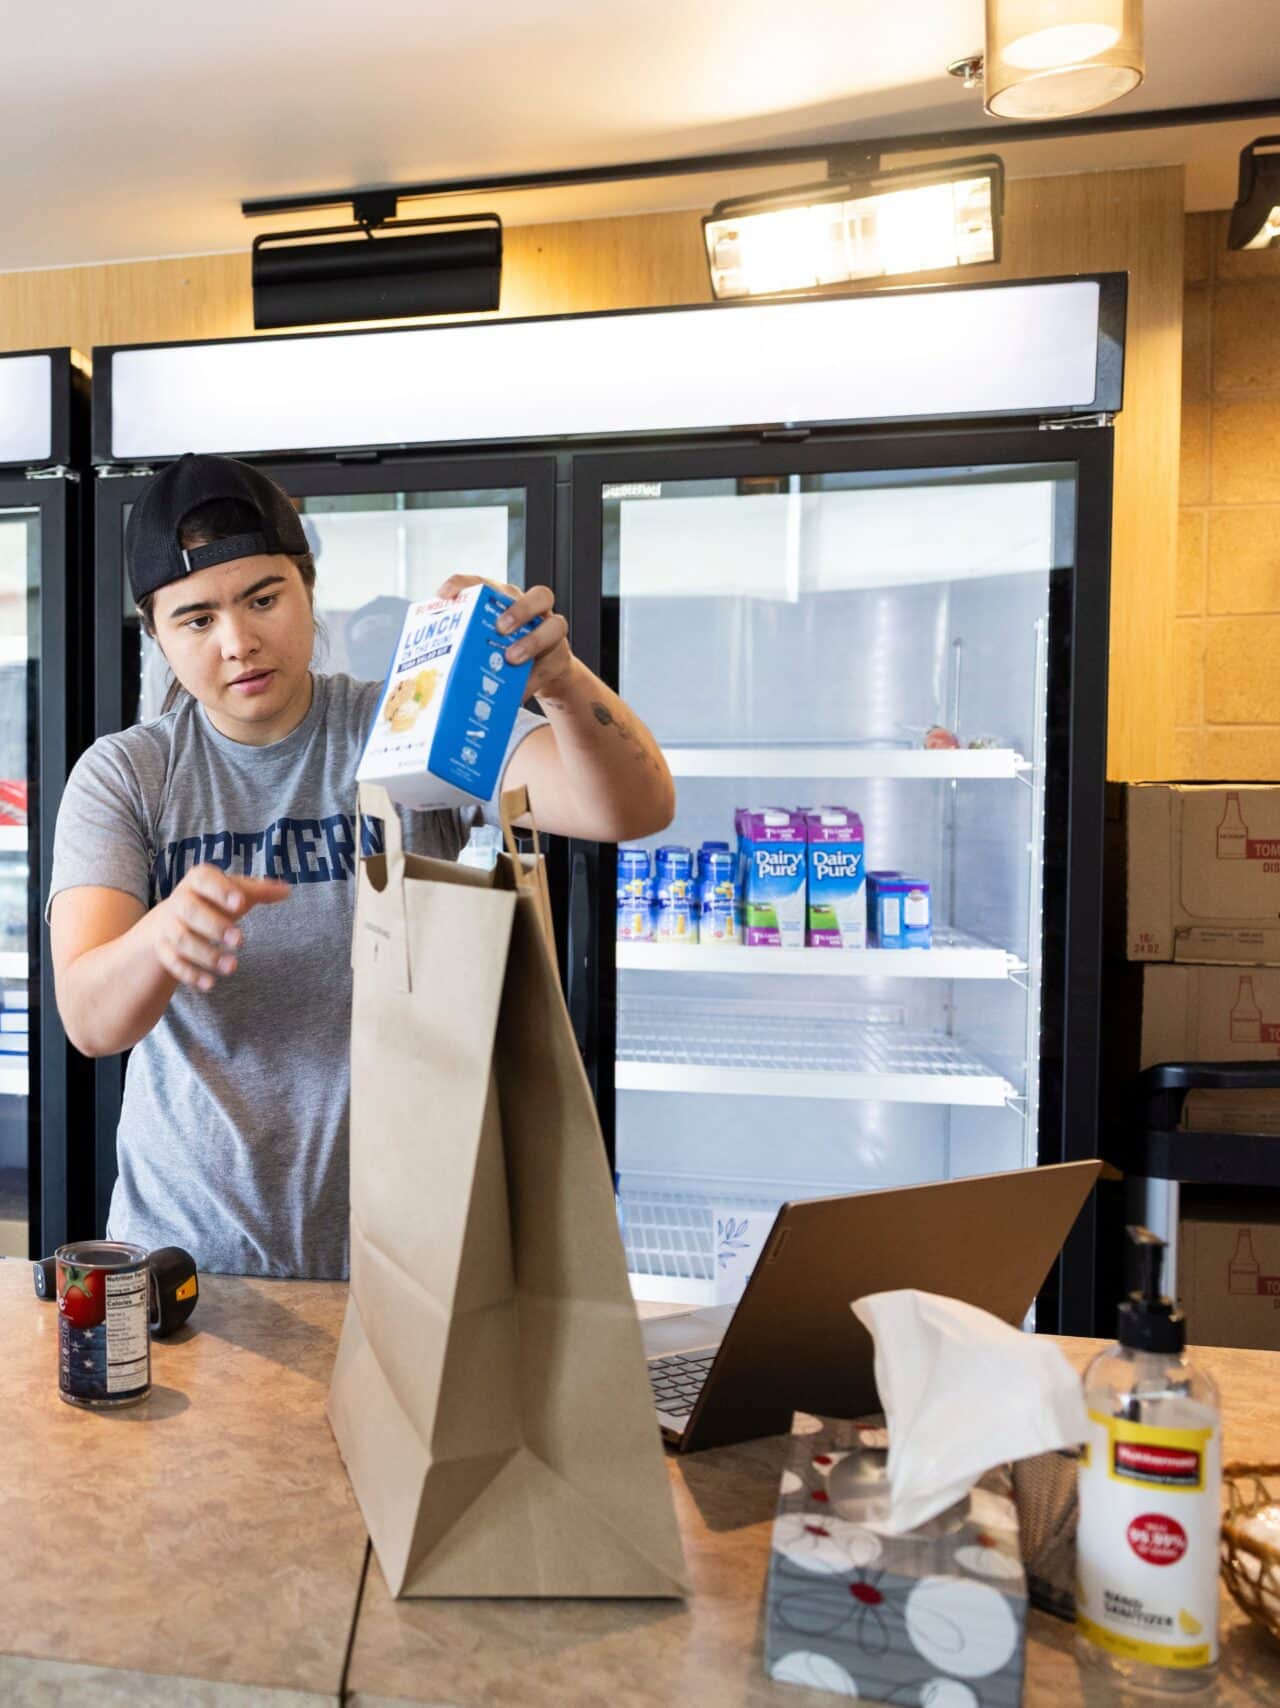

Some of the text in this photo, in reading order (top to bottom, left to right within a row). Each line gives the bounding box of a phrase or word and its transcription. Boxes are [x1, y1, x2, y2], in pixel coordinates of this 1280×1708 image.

[404, 611, 463, 648] LUNCH
[756, 851, 803, 867] Dairy
[813, 851, 861, 867] Dairy
[759, 864, 797, 879] Pure
[817, 865, 857, 880] Pure
[107, 1299, 132, 1307] Calories
